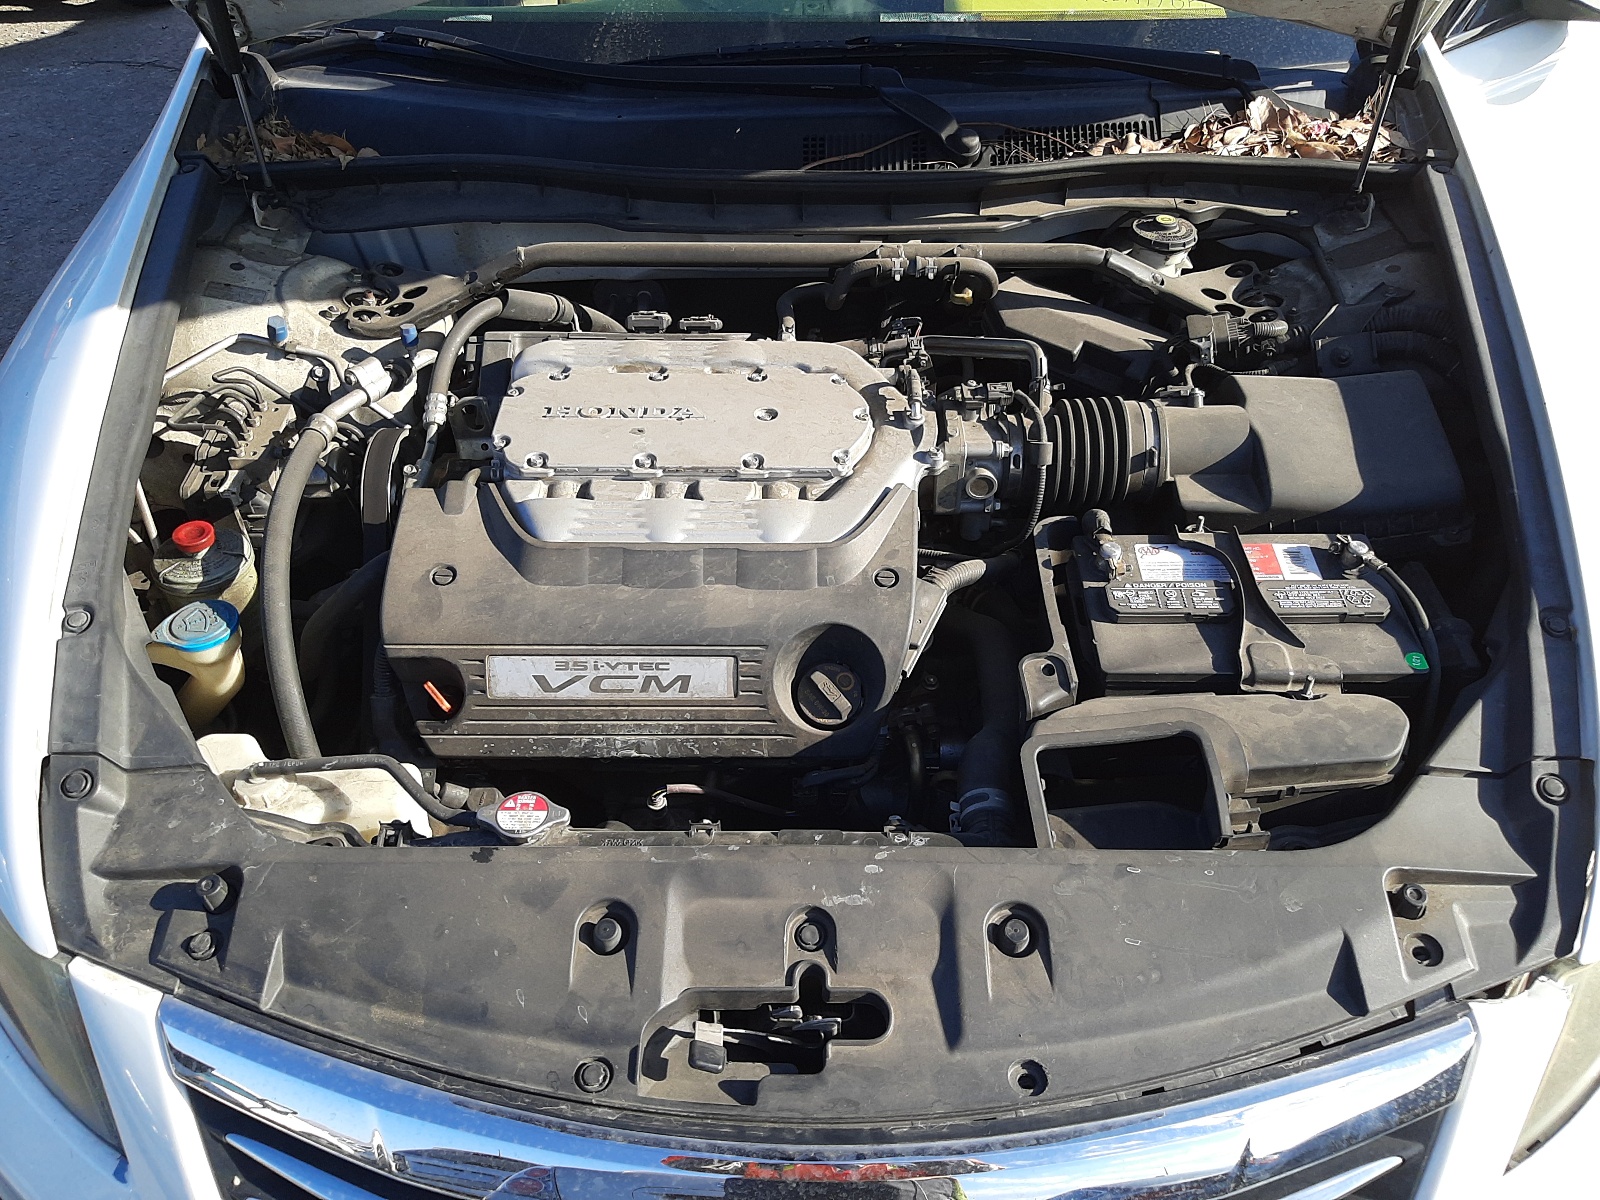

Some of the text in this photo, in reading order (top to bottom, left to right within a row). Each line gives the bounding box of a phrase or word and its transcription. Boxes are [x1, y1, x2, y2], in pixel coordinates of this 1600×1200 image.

[541, 406, 706, 420] HONDA
[593, 660, 670, 671] i-VTEC
[531, 674, 692, 693] VCM
